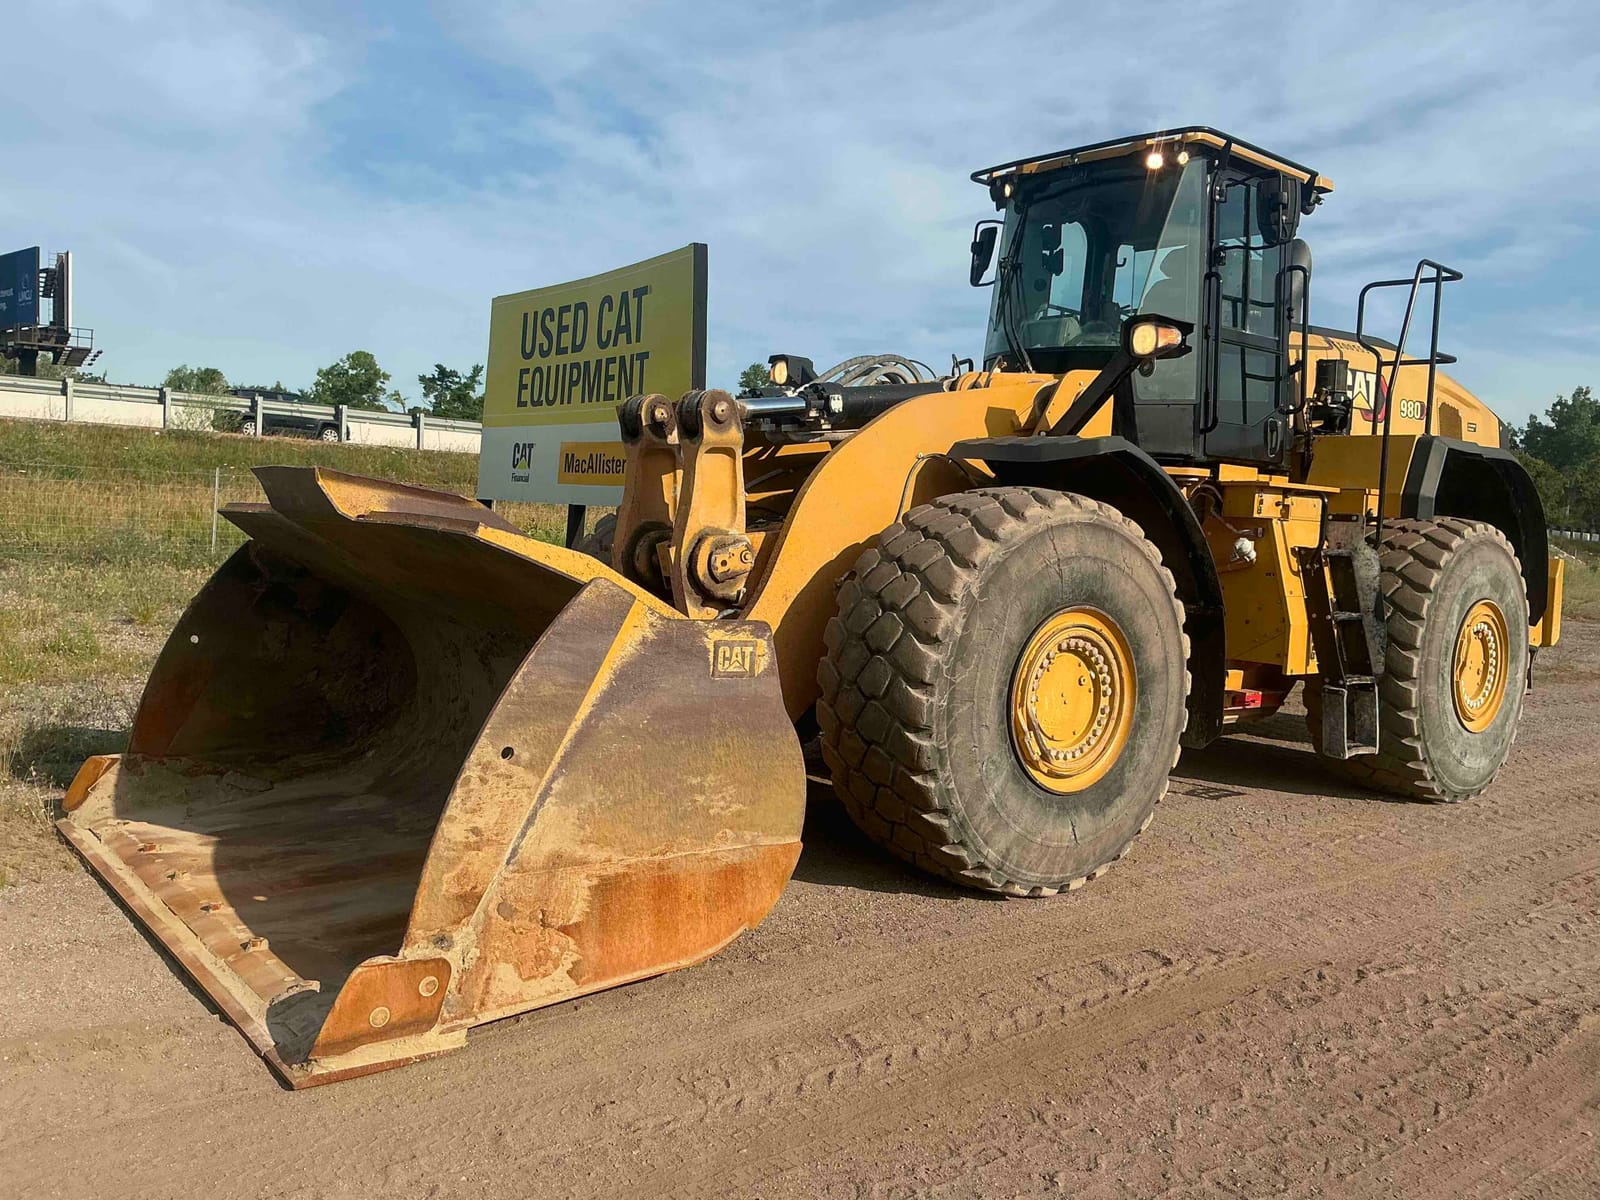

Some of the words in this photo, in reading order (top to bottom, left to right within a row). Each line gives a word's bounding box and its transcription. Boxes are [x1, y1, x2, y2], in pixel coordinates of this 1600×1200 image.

[520, 301, 589, 361] USED
[596, 285, 649, 350] CAT
[516, 351, 650, 408] EQUIPMENT
[1400, 399, 1421, 419] 980
[512, 442, 534, 470] CAT
[563, 453, 627, 475] MacAllister
[717, 645, 754, 673] CAT
